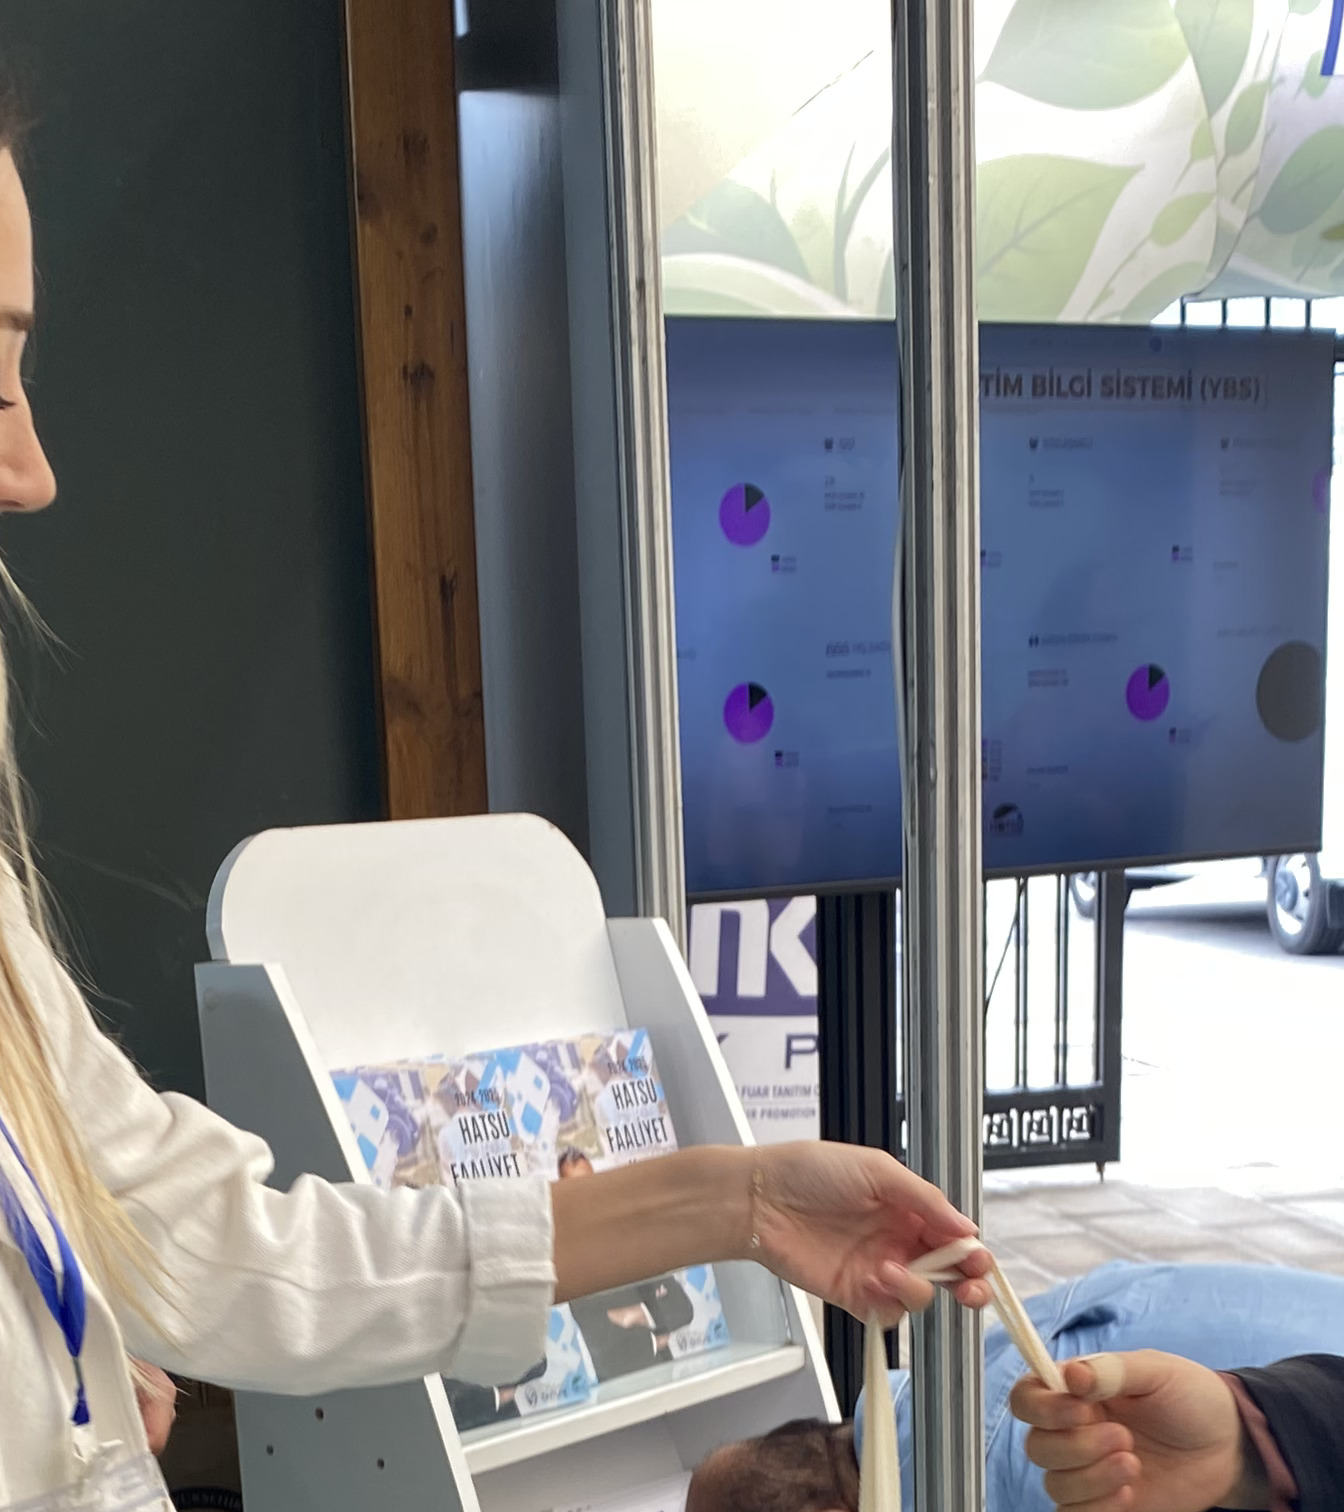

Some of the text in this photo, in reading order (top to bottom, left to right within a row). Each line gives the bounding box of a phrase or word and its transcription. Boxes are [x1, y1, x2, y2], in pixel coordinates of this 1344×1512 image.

[978, 366, 1023, 399] TİM
[1030, 365, 1093, 400] BİLGİ
[1099, 366, 1193, 401] SİSTEMİ
[611, 1077, 657, 1110] HATSU
[740, 1084, 770, 1100] FUAR
[458, 1110, 511, 1146] HATSU
[605, 1117, 668, 1153] FAALİYET
